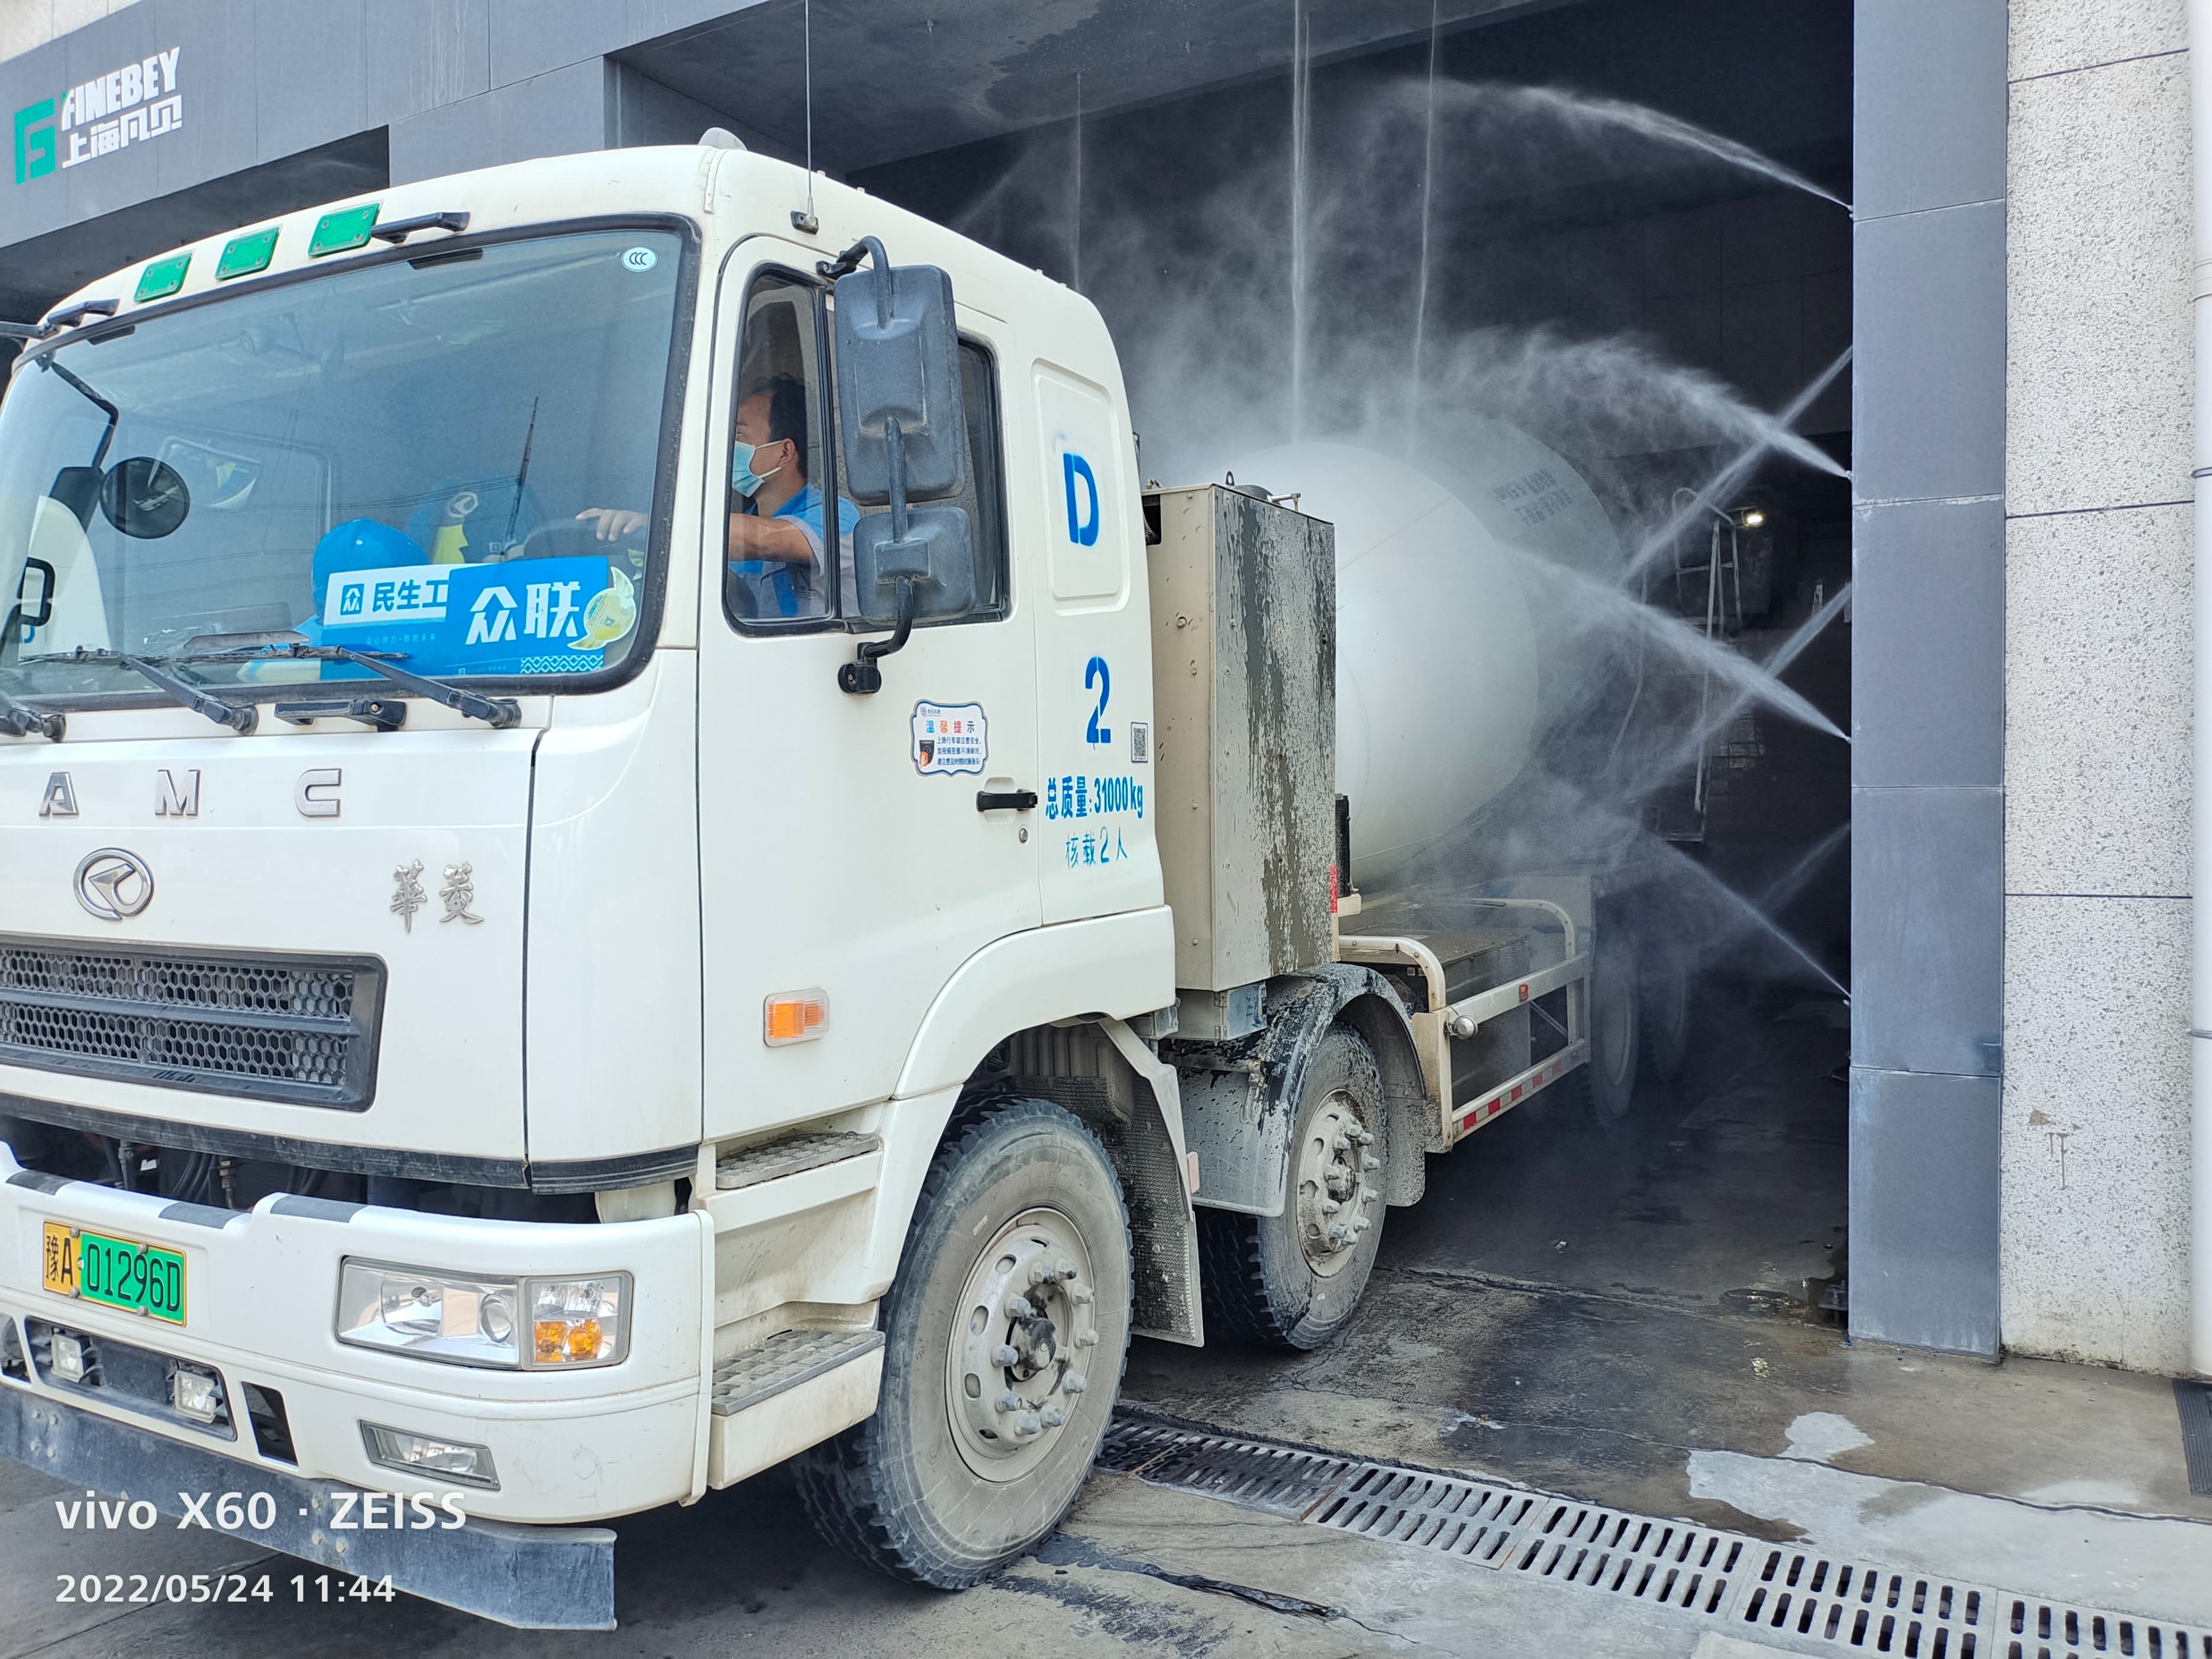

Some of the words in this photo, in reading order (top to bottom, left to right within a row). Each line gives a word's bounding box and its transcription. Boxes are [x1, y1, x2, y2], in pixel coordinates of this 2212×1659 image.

[62, 47, 180, 131] FINEBEY
[1063, 452, 1099, 547] D
[465, 581, 581, 645] 众联
[926, 719, 975, 734] 温馨提示
[1085, 656, 1111, 744] 2
